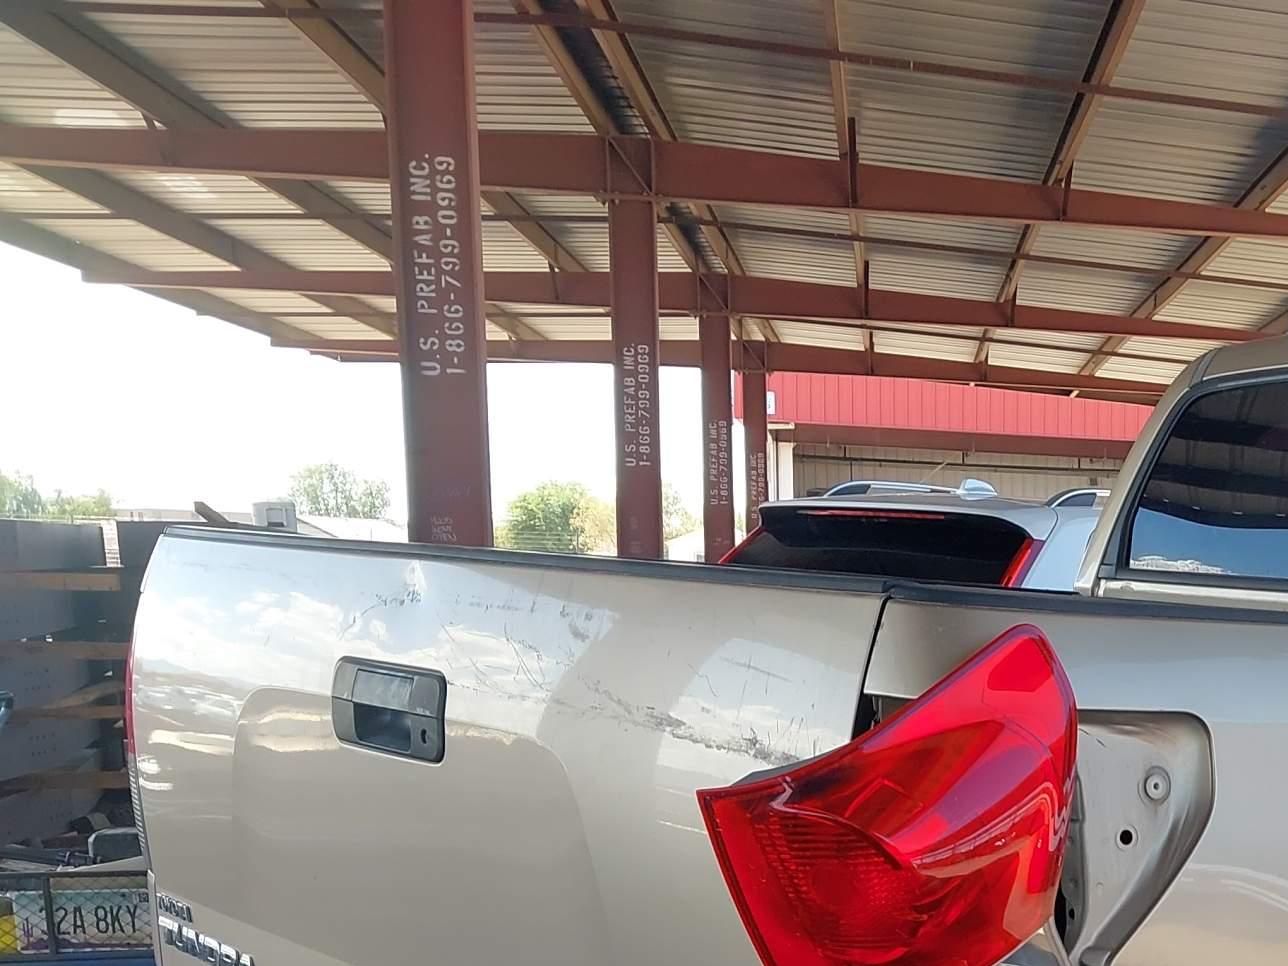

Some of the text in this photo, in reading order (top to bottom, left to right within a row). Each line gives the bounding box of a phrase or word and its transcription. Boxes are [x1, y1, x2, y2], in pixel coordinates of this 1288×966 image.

[408, 153, 441, 376] U.S. PREFAB INC.
[434, 155, 467, 374] 1-866-799-0969
[623, 343, 637, 467] U.S. PREFAB INC.
[637, 344, 651, 466] 1-866-799-0969
[40, 905, 138, 935] 2A 8KY
